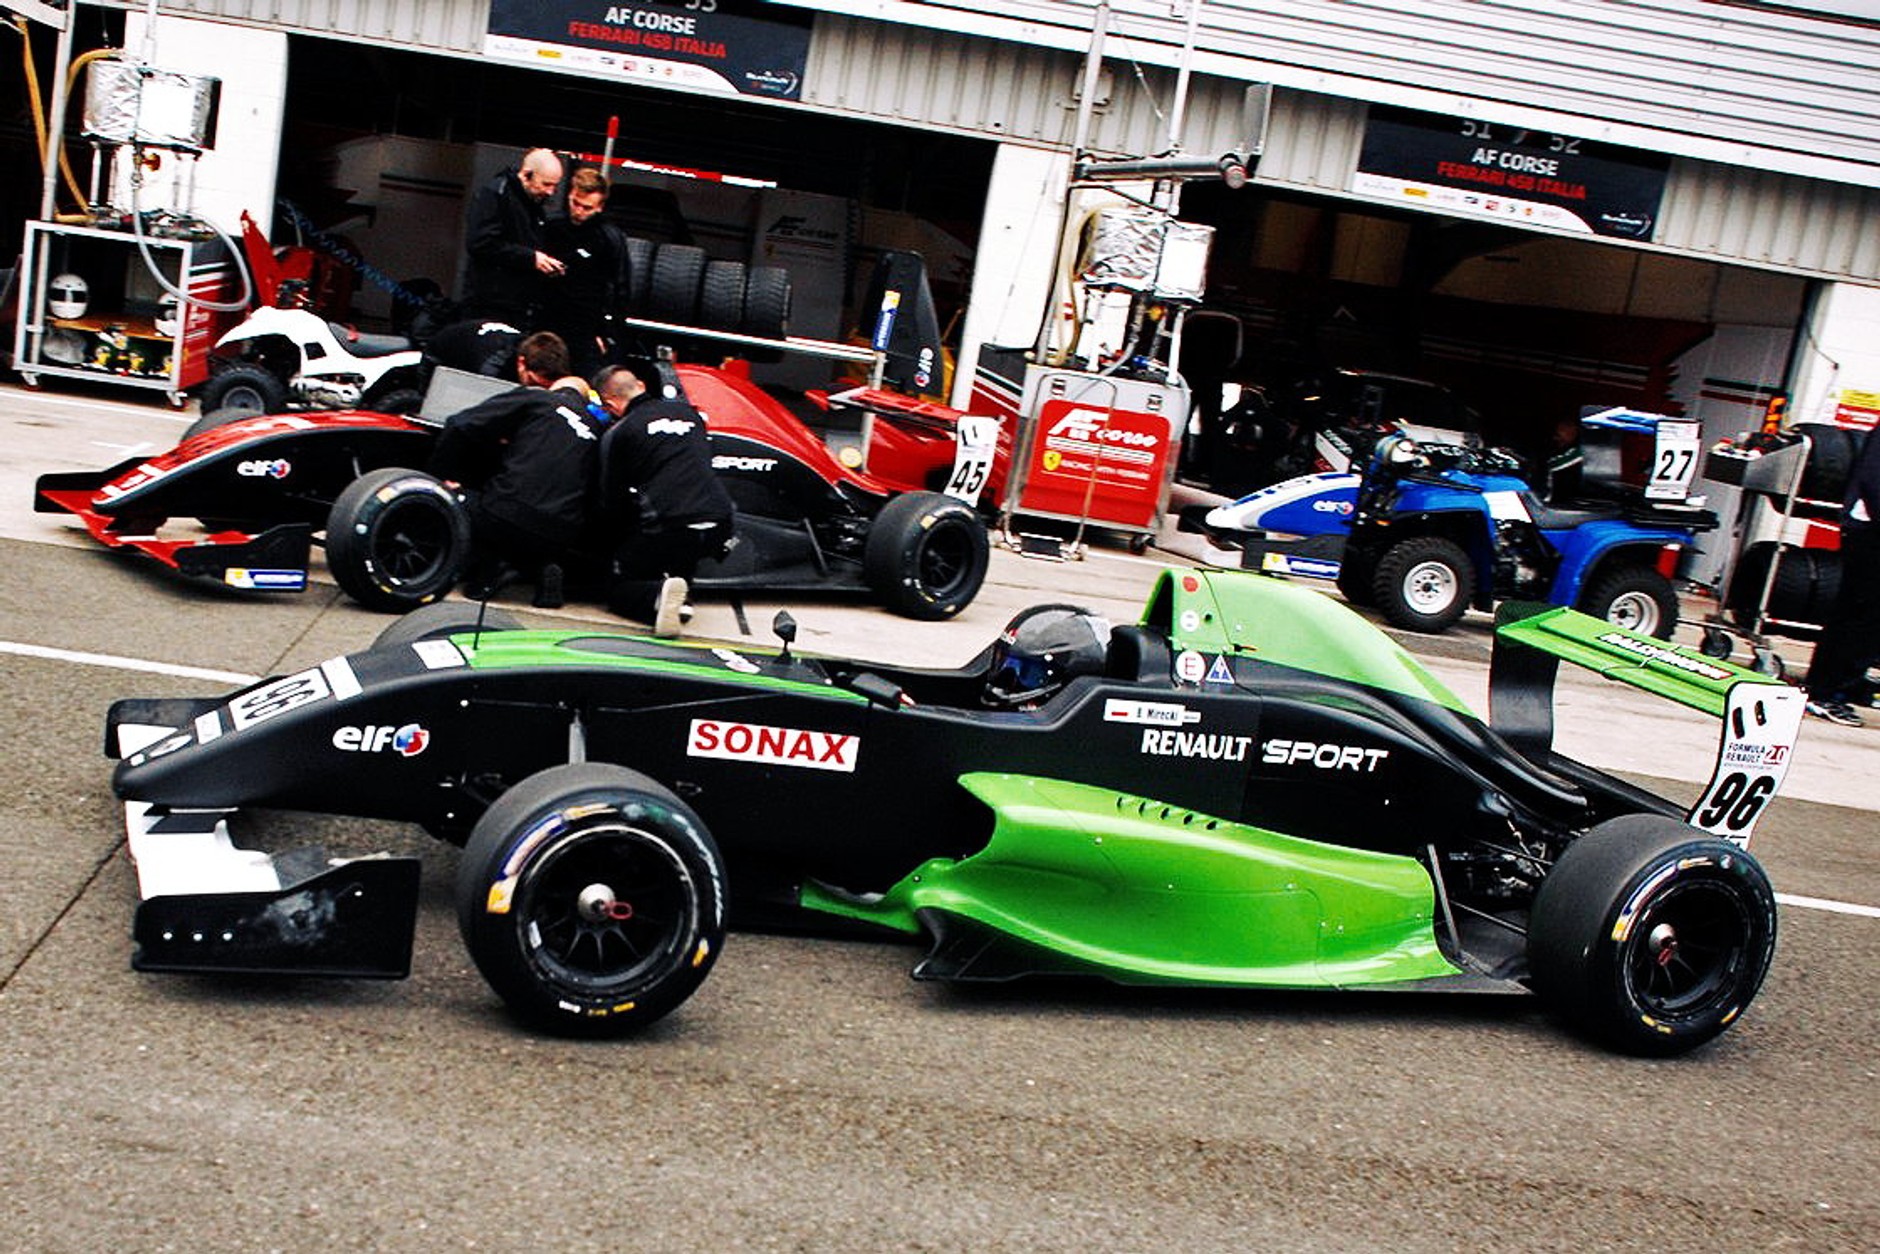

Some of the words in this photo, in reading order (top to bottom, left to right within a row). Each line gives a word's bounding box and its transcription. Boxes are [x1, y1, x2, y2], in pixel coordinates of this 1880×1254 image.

[604, 6, 632, 25] AF
[633, 10, 696, 35] CORSE
[568, 22, 640, 45] FERRARI
[642, 33, 672, 51] 458
[674, 38, 726, 58] ITALIA
[1472, 147, 1499, 165] AF
[1499, 152, 1559, 176] CORSE
[1437, 161, 1505, 186] FERRARI
[1506, 174, 1535, 192] 458
[1536, 178, 1586, 200] ITALIA
[711, 455, 778, 472] SPORT
[950, 461, 987, 495] 45
[1657, 449, 1694, 481] 27
[1185, 656, 1197, 676] E
[332, 725, 395, 752] elf
[694, 722, 850, 764] SONAX
[1141, 728, 1252, 762] RENAULT
[1263, 738, 1389, 772] SPORT
[1728, 742, 1766, 754] FORMULA
[1725, 753, 1761, 764] RENAULT
[1699, 772, 1776, 831] 96
